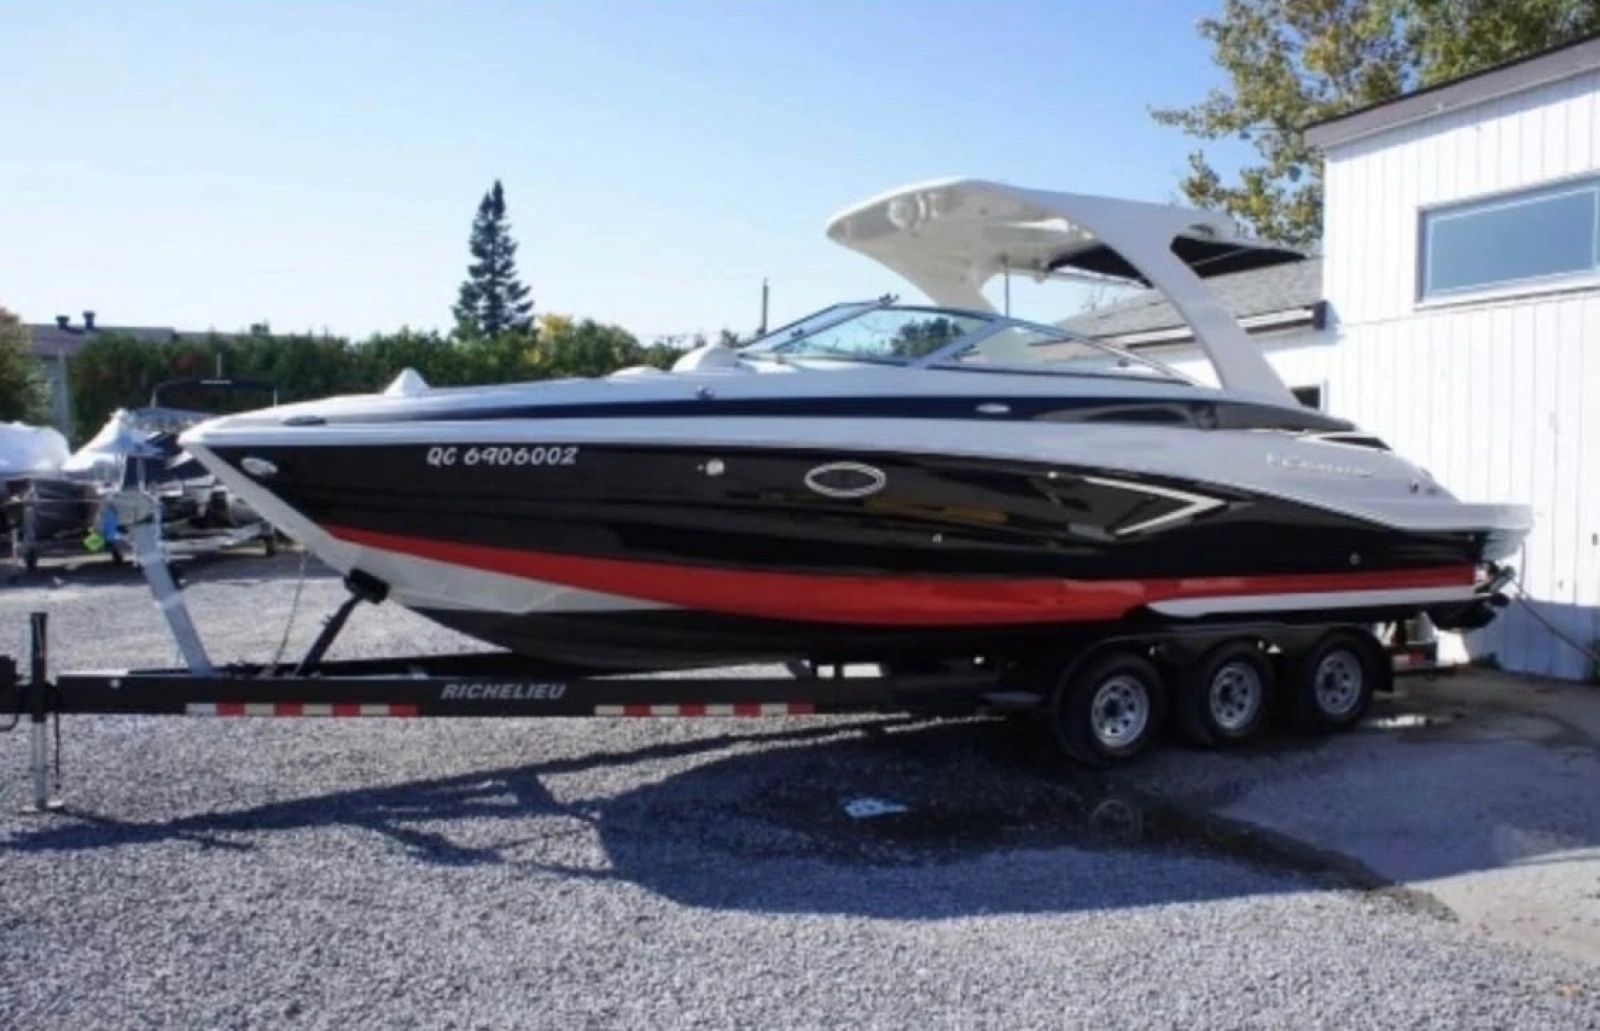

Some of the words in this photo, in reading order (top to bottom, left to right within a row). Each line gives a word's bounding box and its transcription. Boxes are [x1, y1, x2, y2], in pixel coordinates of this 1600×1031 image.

[427, 446, 457, 467] QC
[464, 446, 579, 466] 6906002
[440, 683, 567, 699] RICHELIEU
